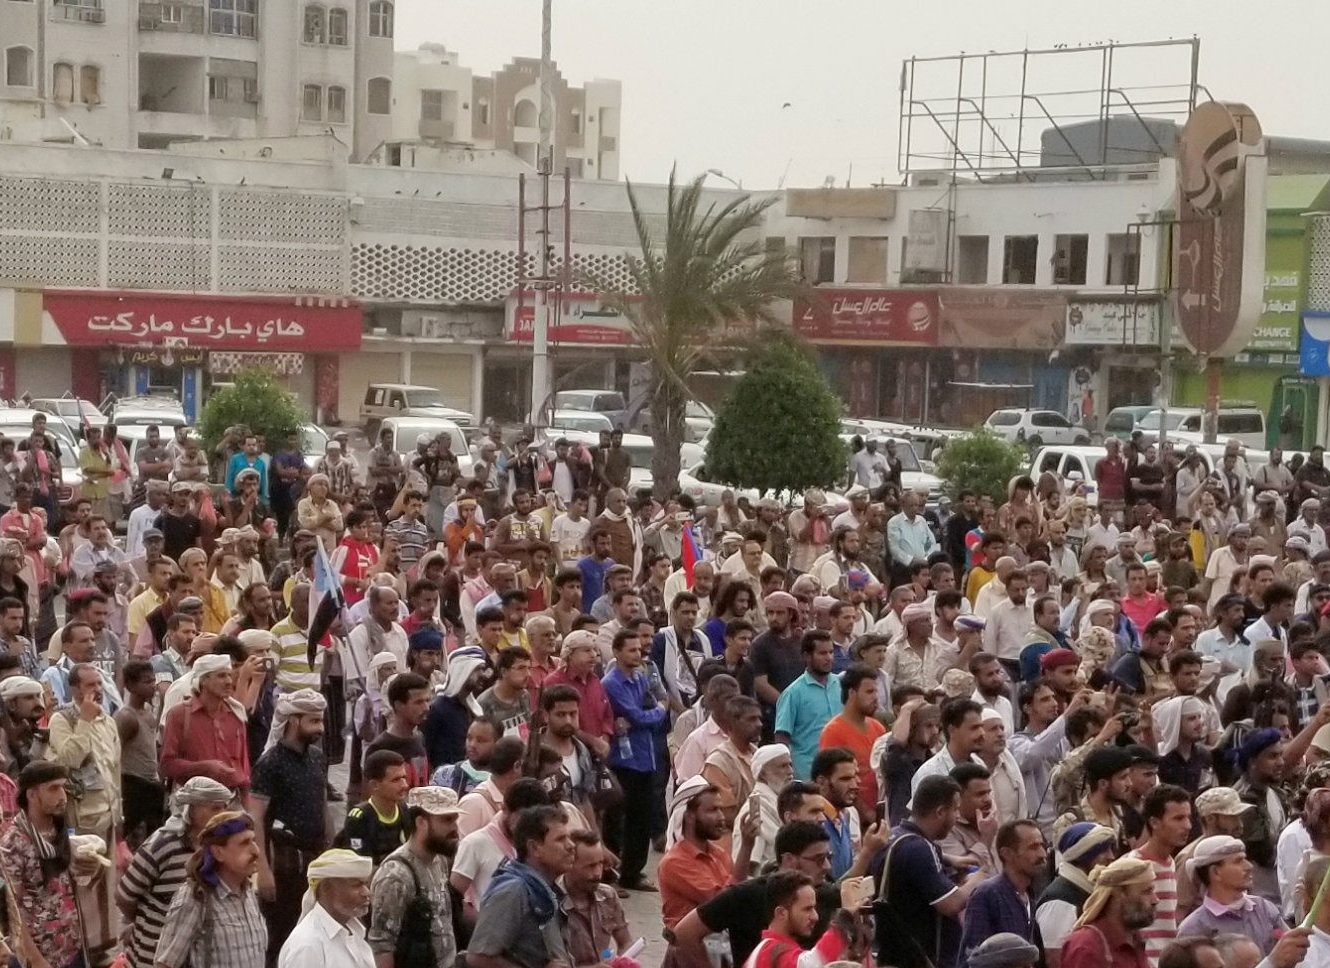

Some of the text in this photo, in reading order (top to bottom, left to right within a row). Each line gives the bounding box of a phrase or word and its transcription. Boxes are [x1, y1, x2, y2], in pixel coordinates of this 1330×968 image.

[87, 311, 305, 342] هاي بارك ماركت
[1253, 326, 1292, 337] CHANGE
